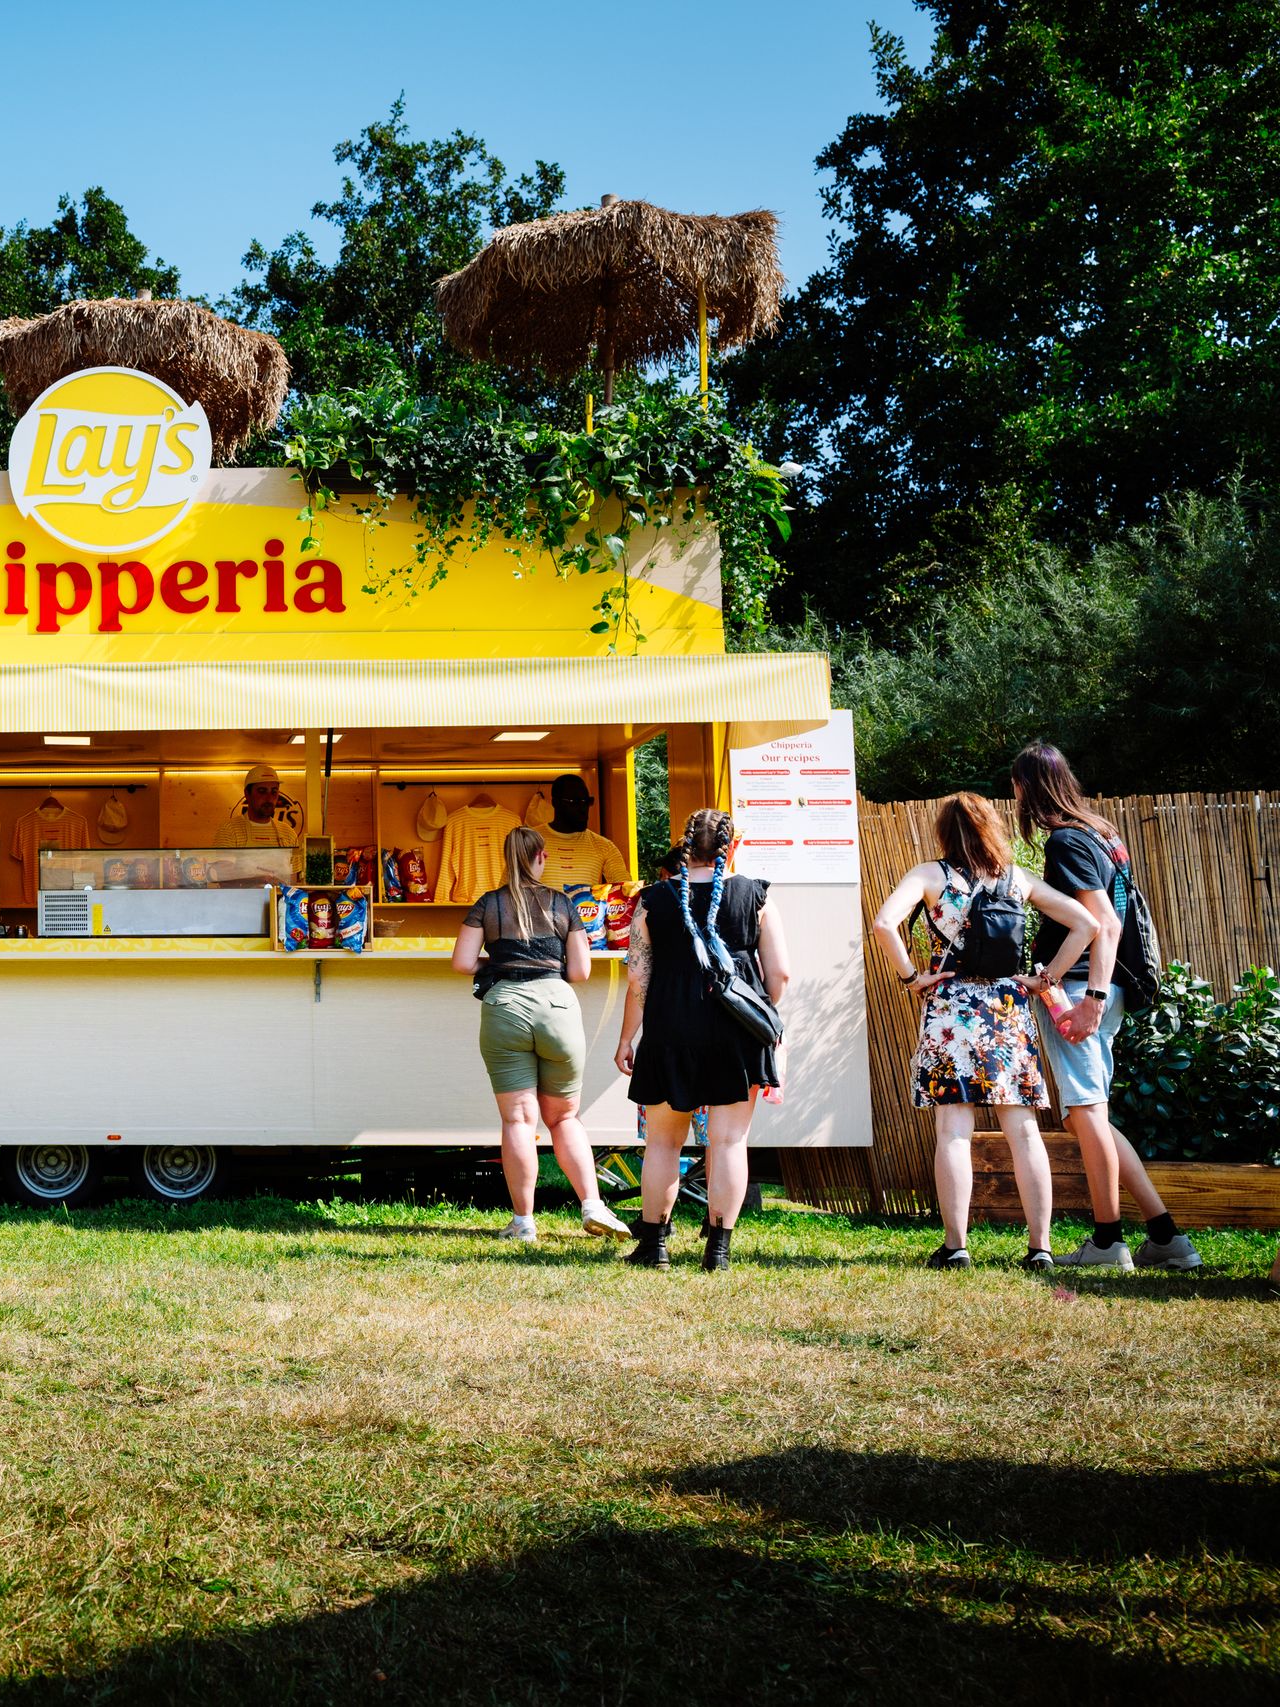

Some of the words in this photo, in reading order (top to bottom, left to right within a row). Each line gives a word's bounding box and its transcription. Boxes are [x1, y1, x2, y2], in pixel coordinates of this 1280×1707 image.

[23, 408, 200, 512] Lay's
[761, 754, 781, 762] Our
[783, 754, 821, 763] recipes
